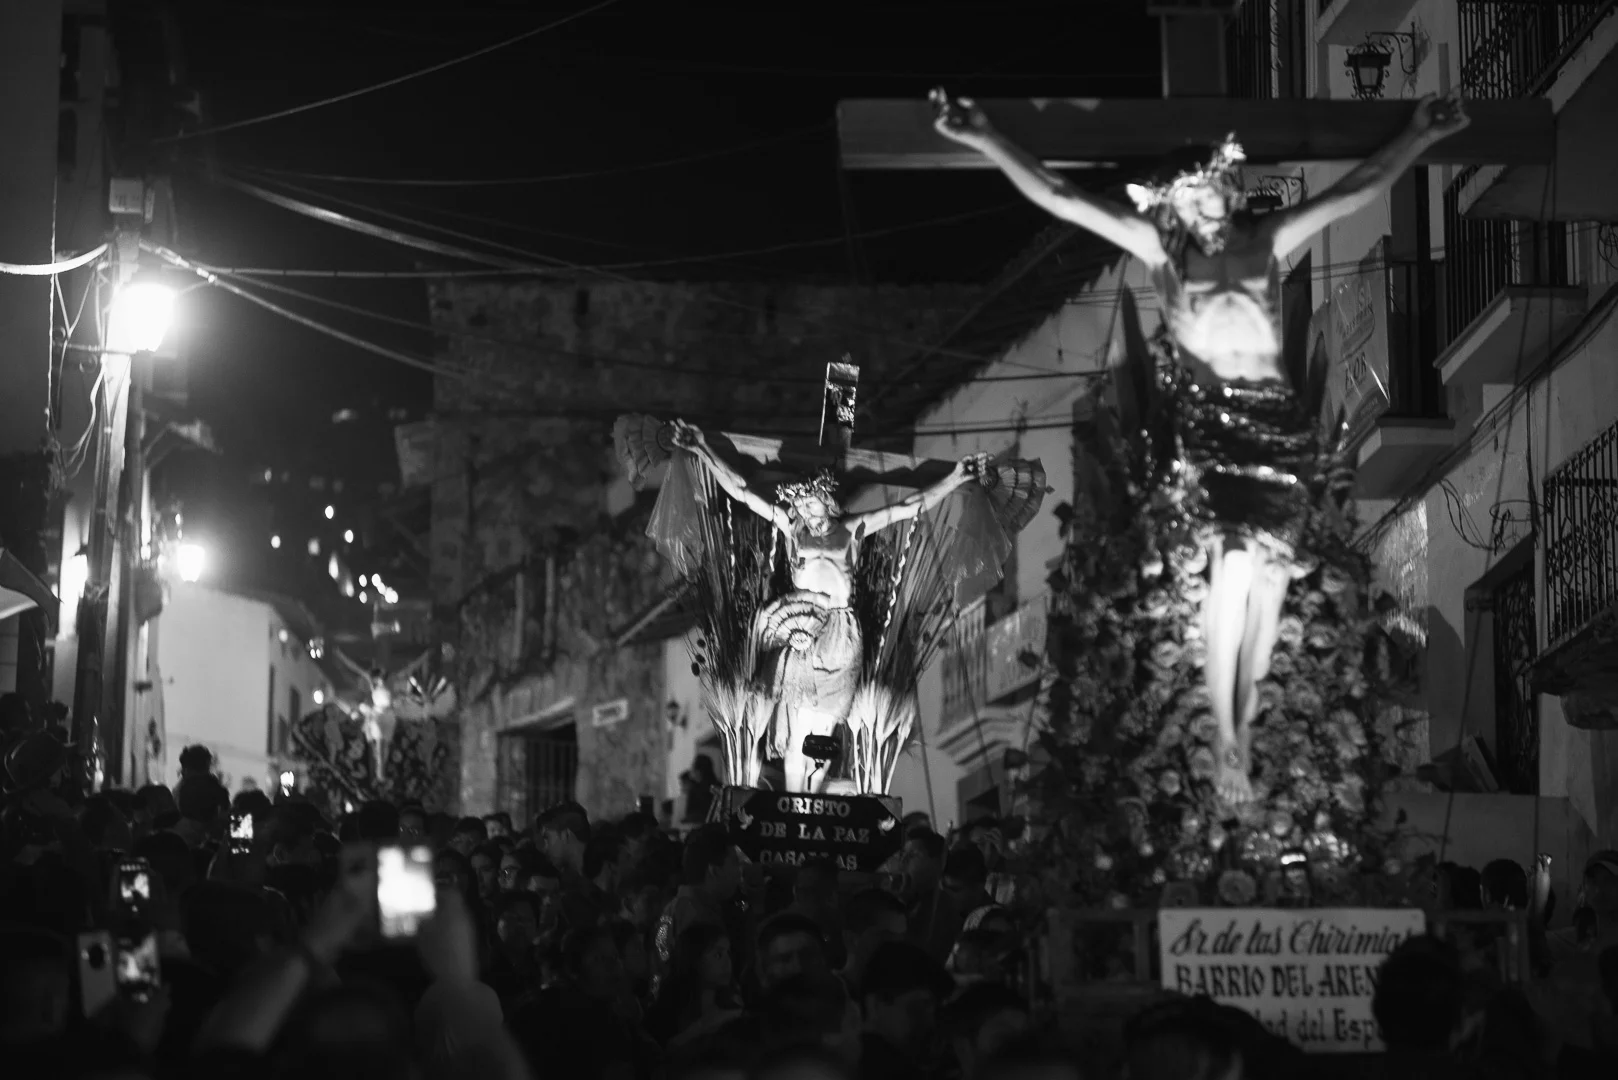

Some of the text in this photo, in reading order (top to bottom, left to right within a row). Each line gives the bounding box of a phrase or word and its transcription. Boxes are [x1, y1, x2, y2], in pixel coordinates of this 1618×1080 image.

[776, 796, 850, 818] CRISTO
[760, 821, 870, 844] DE LA PAZ
[760, 850, 858, 871] CASAAS
[1212, 919, 1243, 954] de
[1245, 919, 1283, 955] las
[1176, 964, 1380, 998] BARRIO DEL AREN
[1296, 1008, 1328, 1042] del
[1333, 1007, 1381, 1049] Esp
